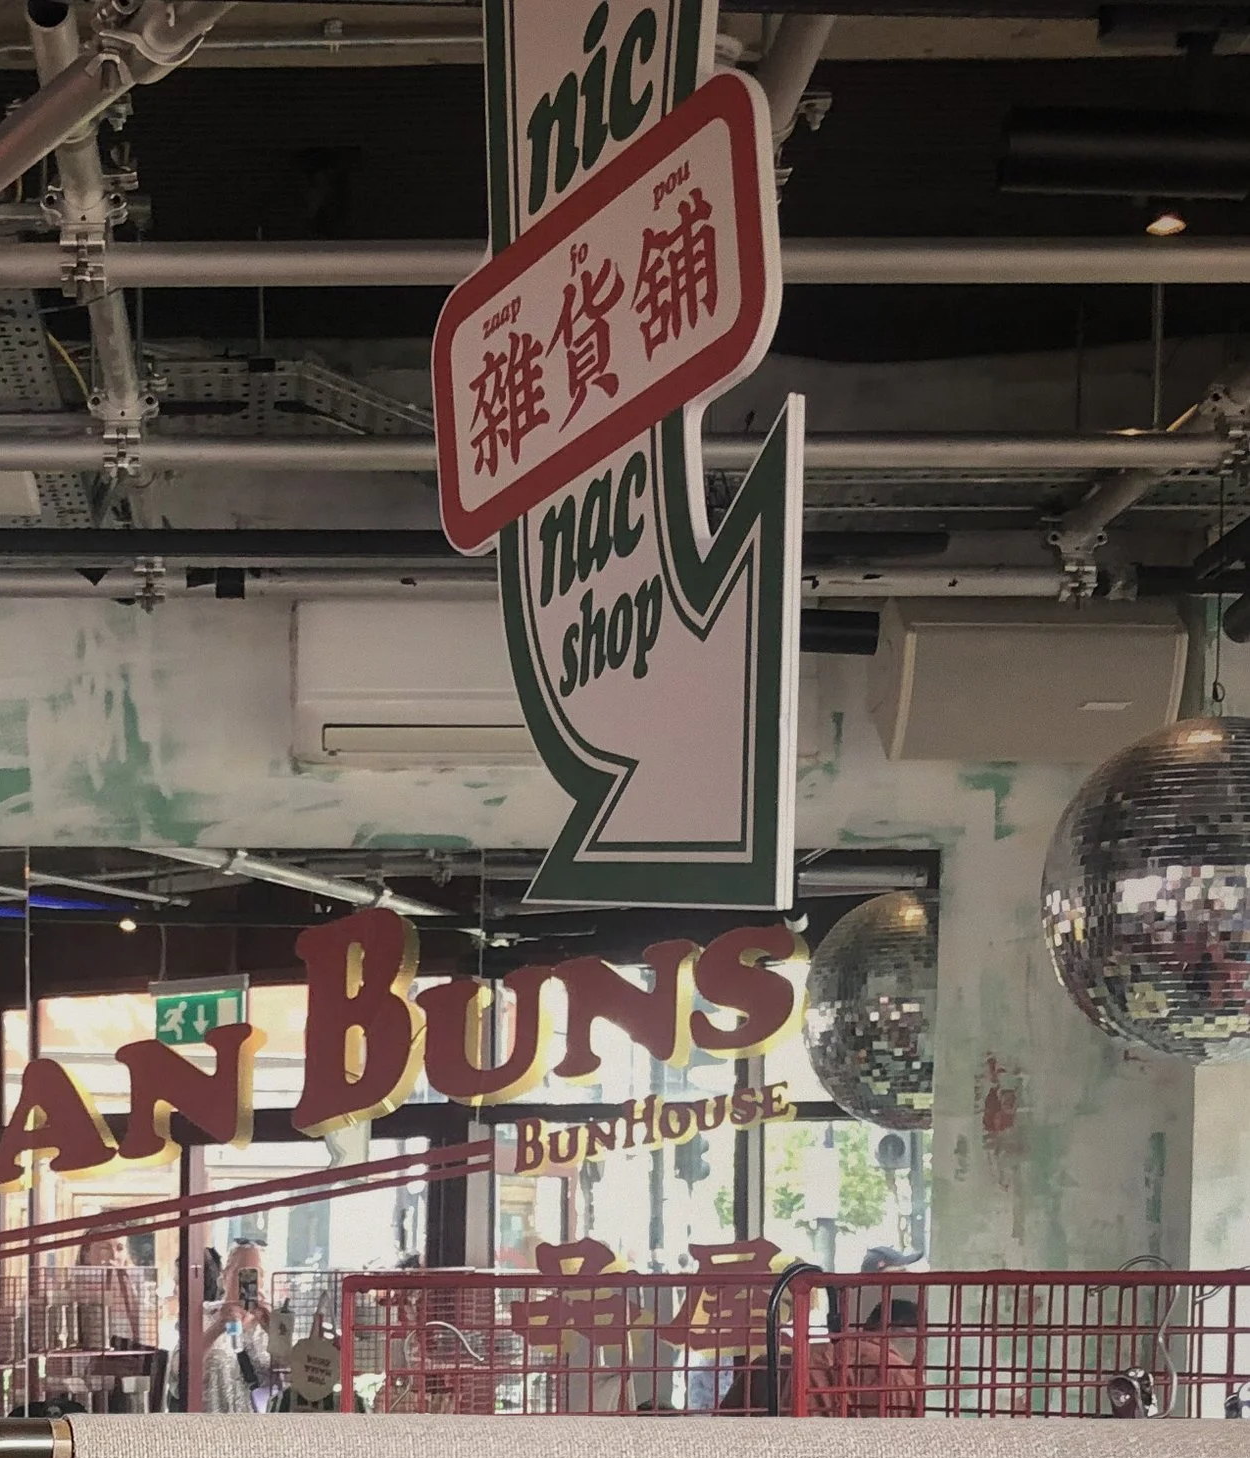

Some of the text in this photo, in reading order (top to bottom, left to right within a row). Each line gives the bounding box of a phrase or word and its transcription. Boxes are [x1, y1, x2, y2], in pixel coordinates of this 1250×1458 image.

[526, 1, 657, 216] nic
[482, 296, 522, 340] zaap
[652, 160, 691, 211] pou
[539, 451, 648, 608] nac
[558, 574, 663, 698] shop
[291, 907, 805, 1134] BUNS
